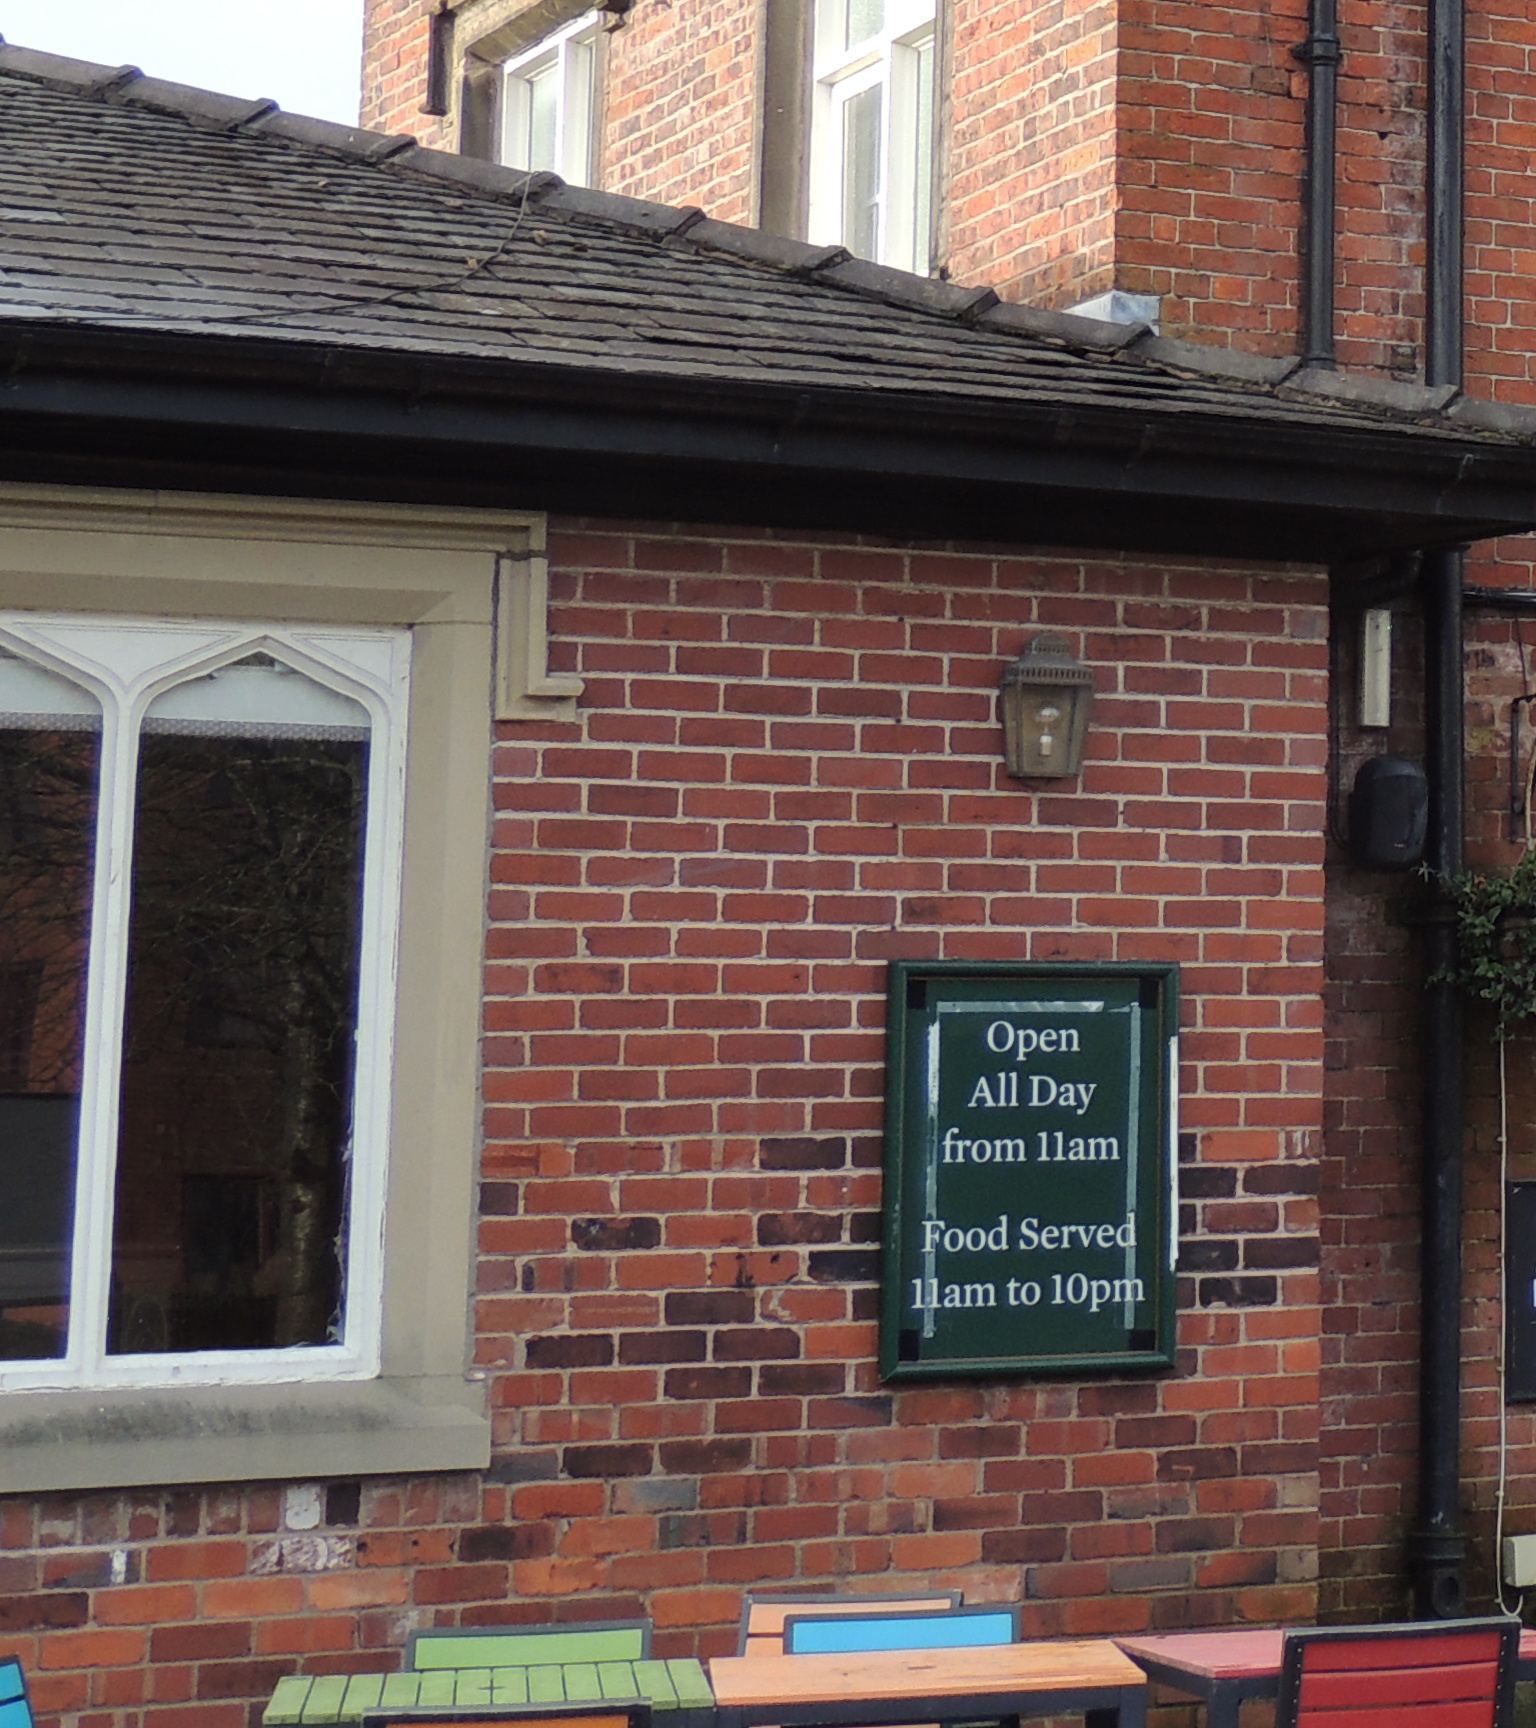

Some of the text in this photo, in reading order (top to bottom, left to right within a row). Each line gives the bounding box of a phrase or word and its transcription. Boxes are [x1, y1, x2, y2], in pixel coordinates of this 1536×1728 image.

[986, 1020, 1080, 1061] Open
[968, 1072, 1097, 1115] All Day
[942, 1128, 1121, 1163] from 11am
[920, 1212, 1138, 1253] Food Served
[911, 1272, 1146, 1312] 11am to 10pm
